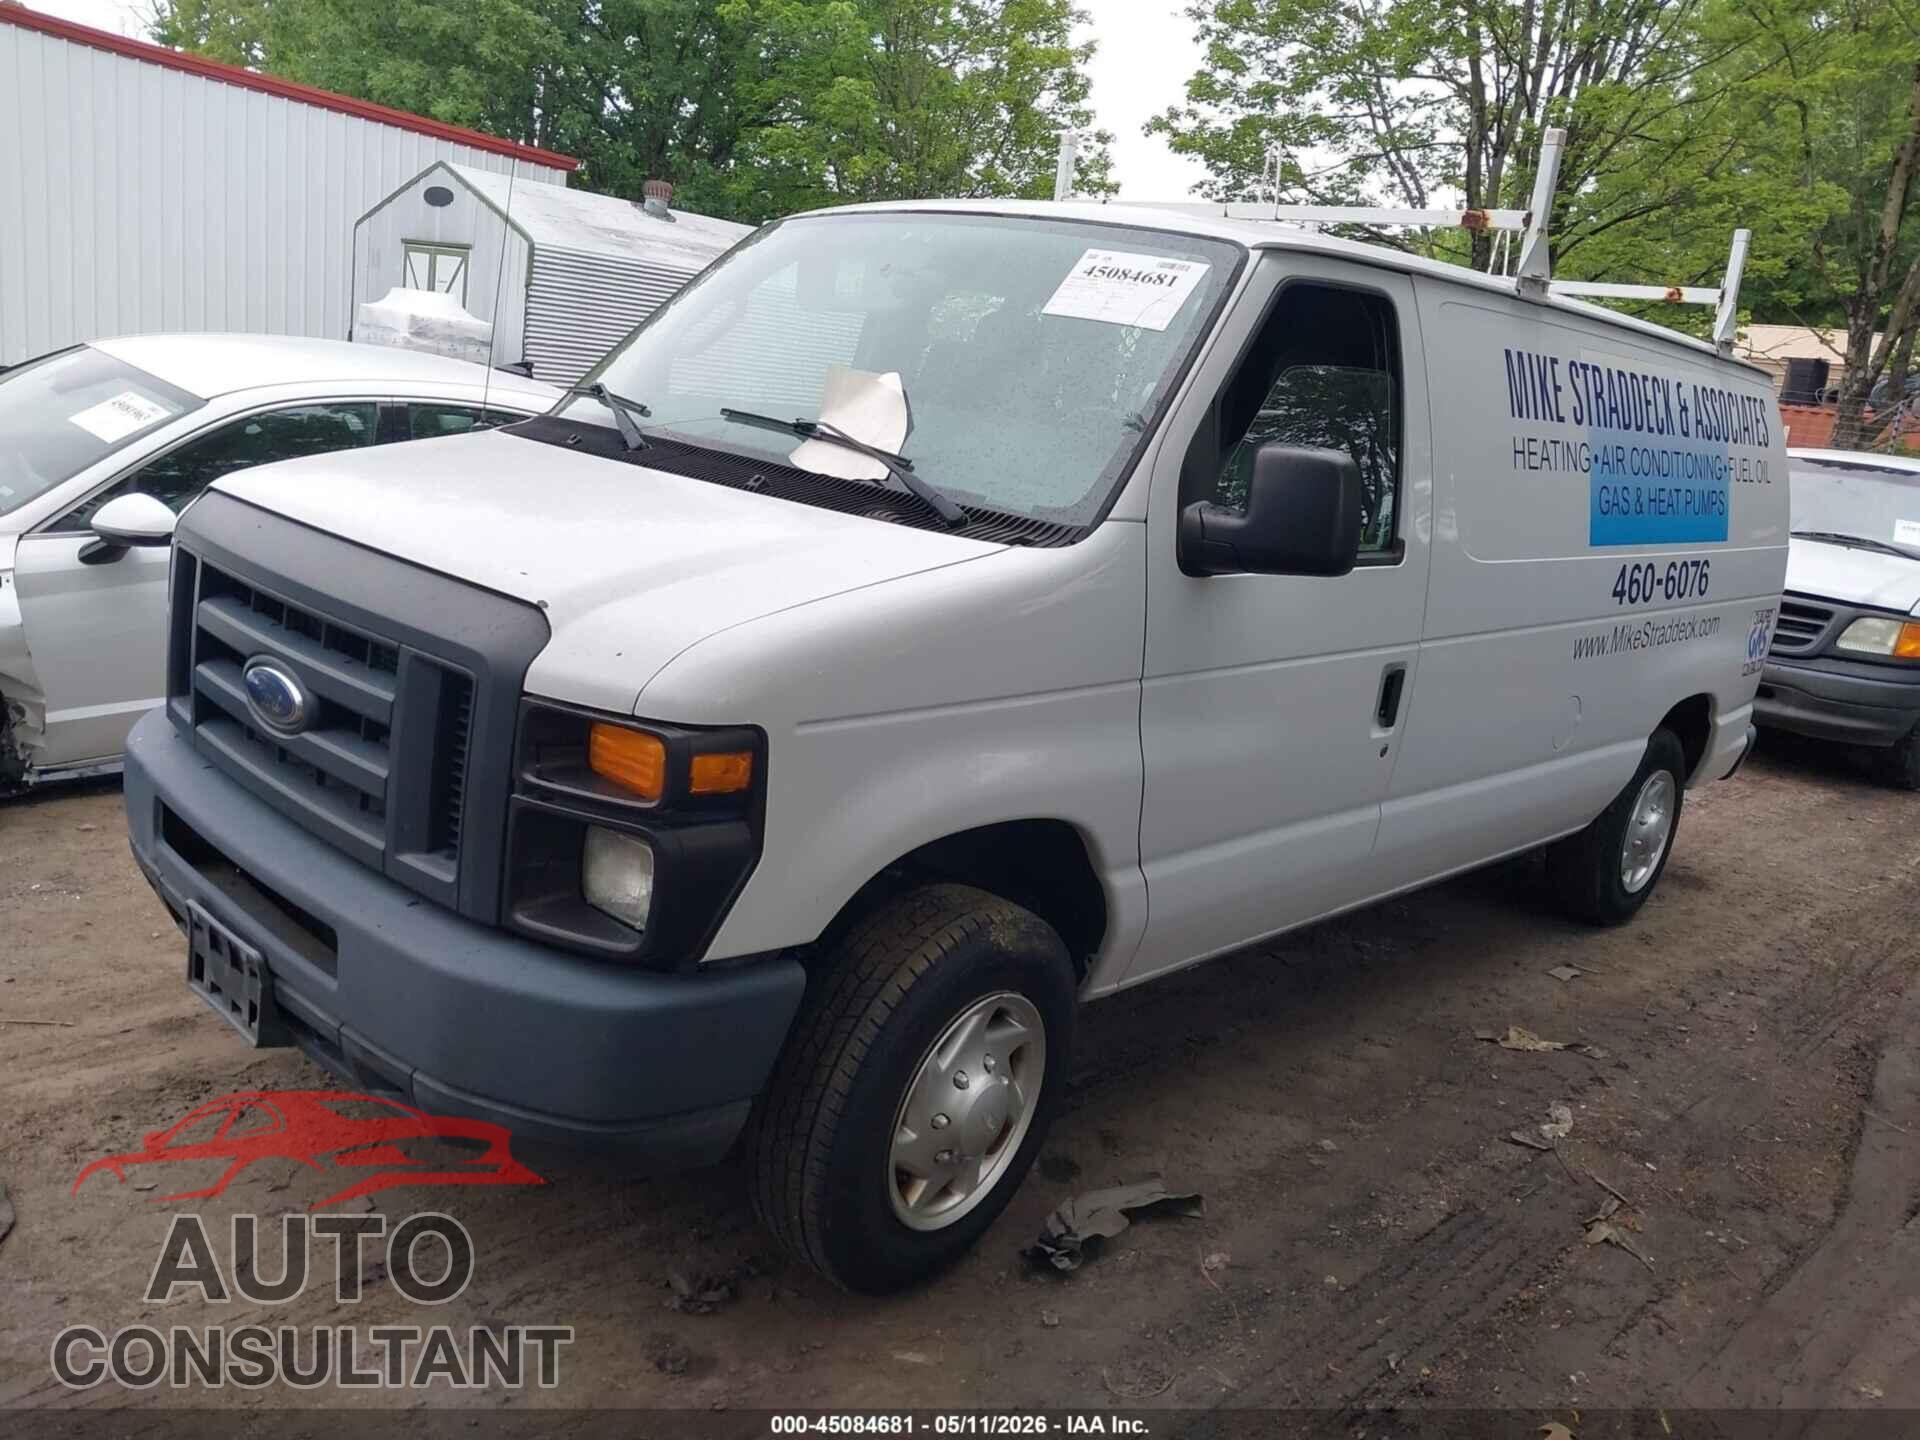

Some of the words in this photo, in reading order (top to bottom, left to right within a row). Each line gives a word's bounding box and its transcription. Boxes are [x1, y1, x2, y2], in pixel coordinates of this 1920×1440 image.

[1083, 264, 1178, 287] 45084681
[1504, 349, 1566, 423] MIKE
[1569, 360, 1675, 435] STRADDECK
[1677, 382, 1689, 437] &
[1694, 385, 1769, 448] ASSOCIATES
[1513, 437, 1591, 474] HEATING
[1600, 487, 1630, 515] GAS
[1635, 489, 1643, 514] &
[1648, 488, 1681, 515] HEAT
[1685, 490, 1725, 516] PUMPS
[1612, 559, 1710, 606] 460-6076
[1573, 616, 1720, 661] www.MikeStraddeck.com
